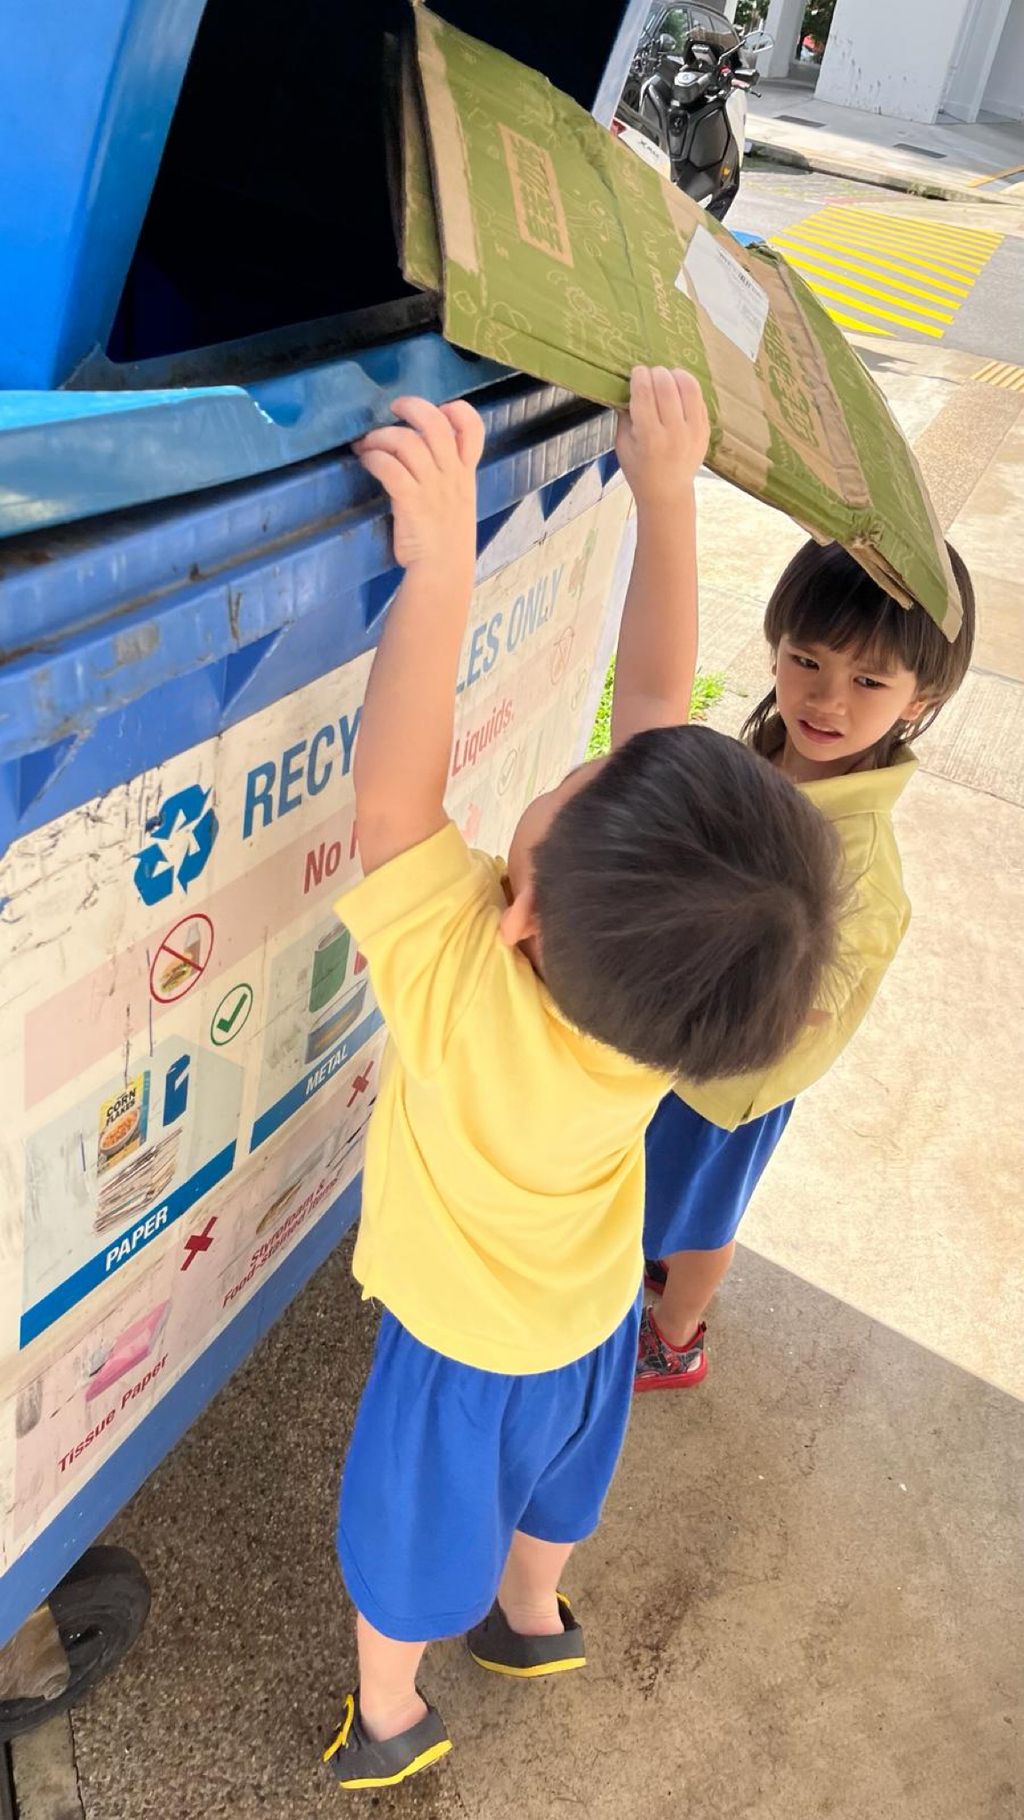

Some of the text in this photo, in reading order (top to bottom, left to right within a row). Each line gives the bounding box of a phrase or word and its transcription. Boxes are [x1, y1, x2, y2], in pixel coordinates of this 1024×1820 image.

[506, 563, 564, 653] ONLY
[304, 841, 342, 894] No
[305, 1043, 348, 1095] METAL
[106, 1087, 136, 1118] CORN
[105, 1205, 168, 1272] PAPER
[59, 1353, 168, 1473] Tissue Paper
